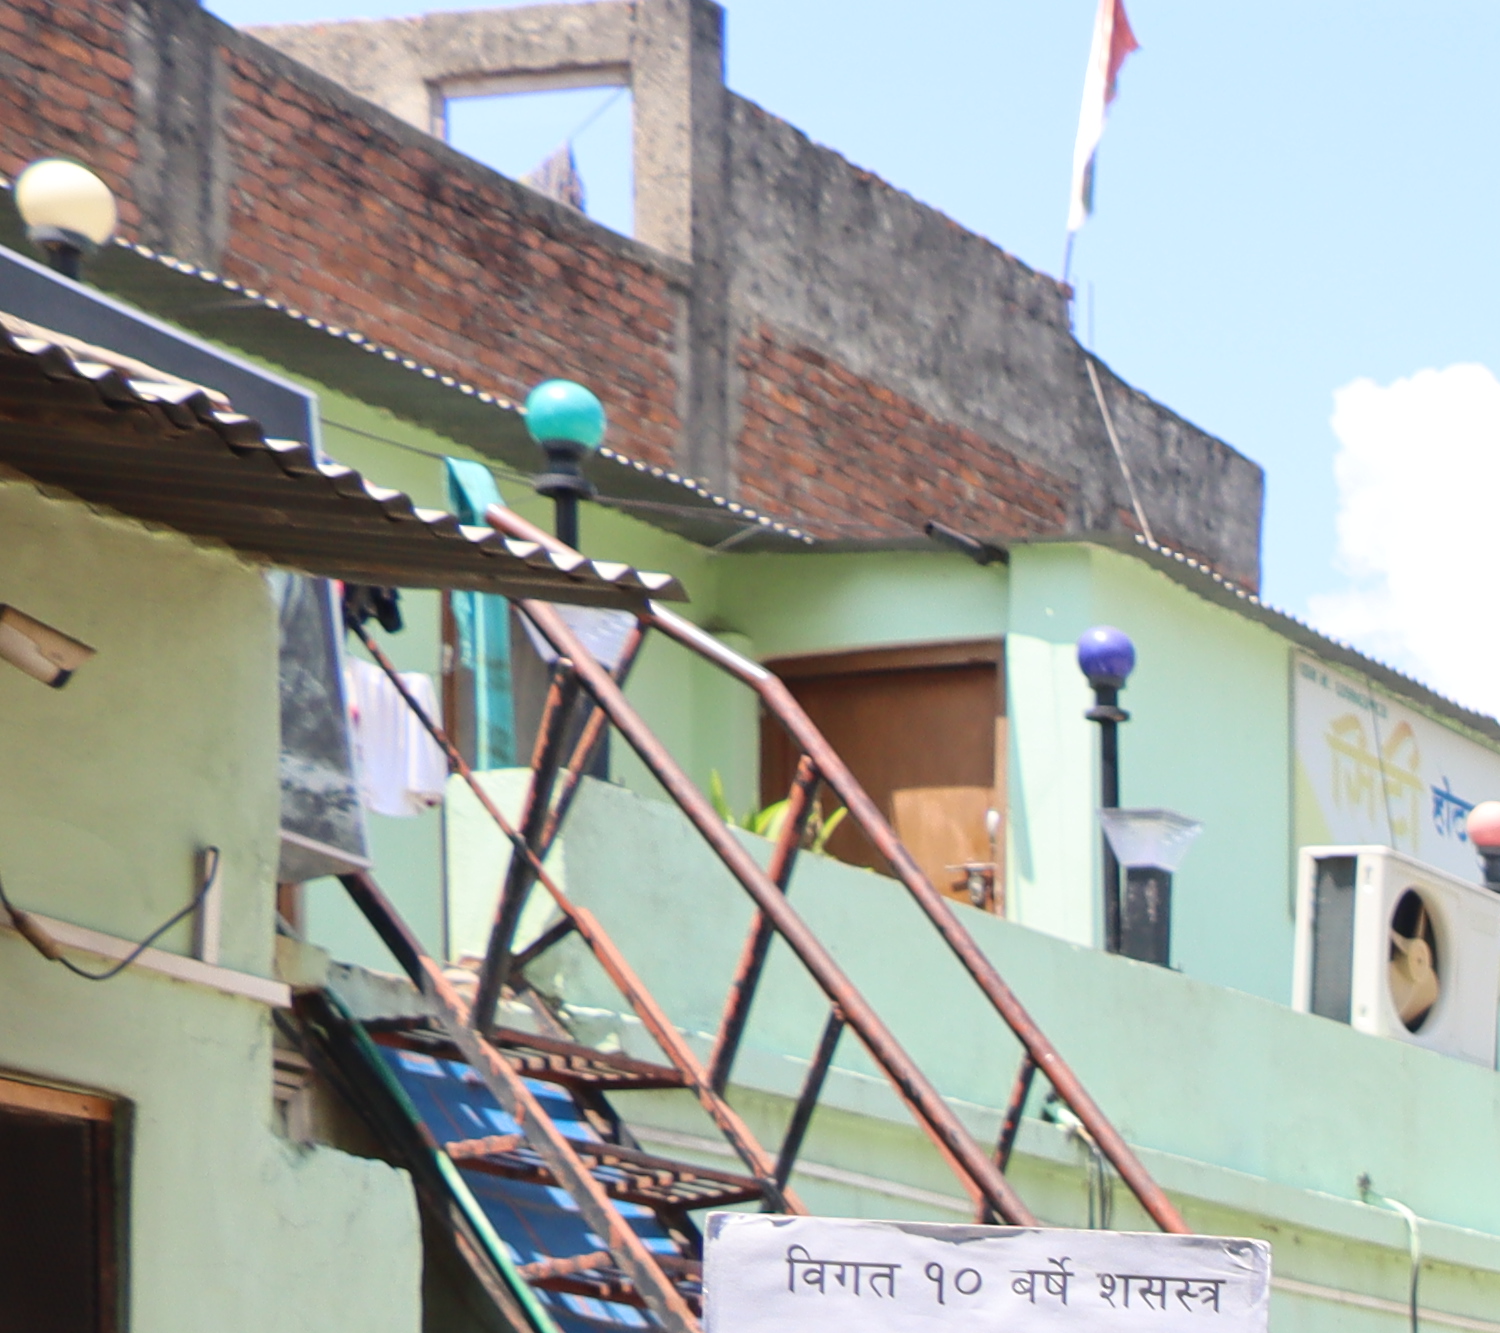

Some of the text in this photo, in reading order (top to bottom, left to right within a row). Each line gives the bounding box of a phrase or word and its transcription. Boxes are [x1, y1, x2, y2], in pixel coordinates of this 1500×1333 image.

[786, 1246, 1227, 1313] विगत १० बर्षे शसस्त्र
